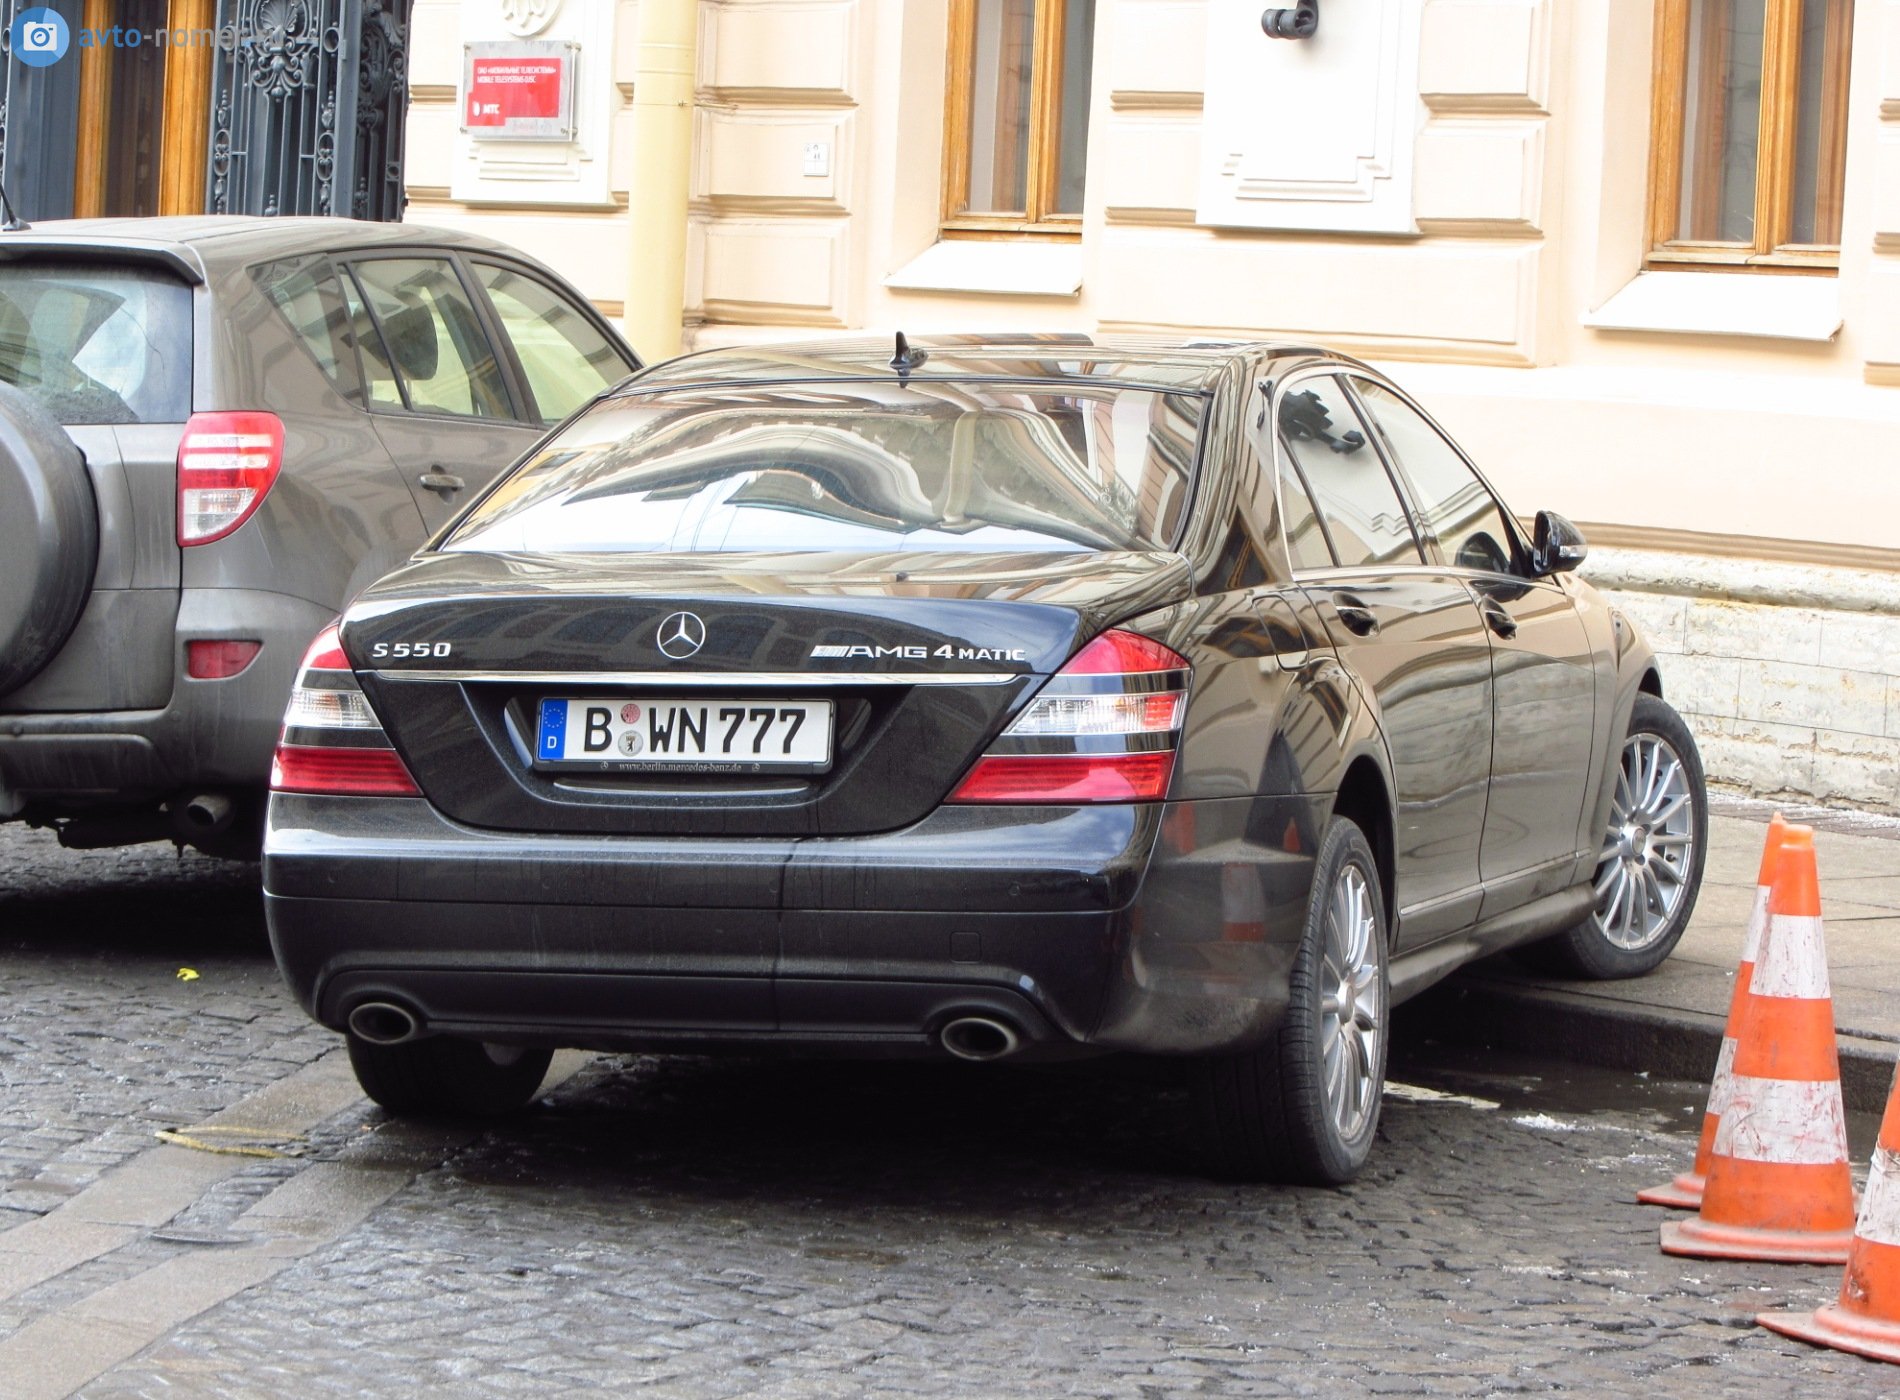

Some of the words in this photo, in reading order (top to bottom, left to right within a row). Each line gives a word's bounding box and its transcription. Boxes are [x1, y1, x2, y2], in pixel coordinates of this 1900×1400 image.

[547, 735, 558, 749] D
[583, 706, 613, 752] B
[648, 706, 709, 753] WN
[718, 707, 807, 754] 777
